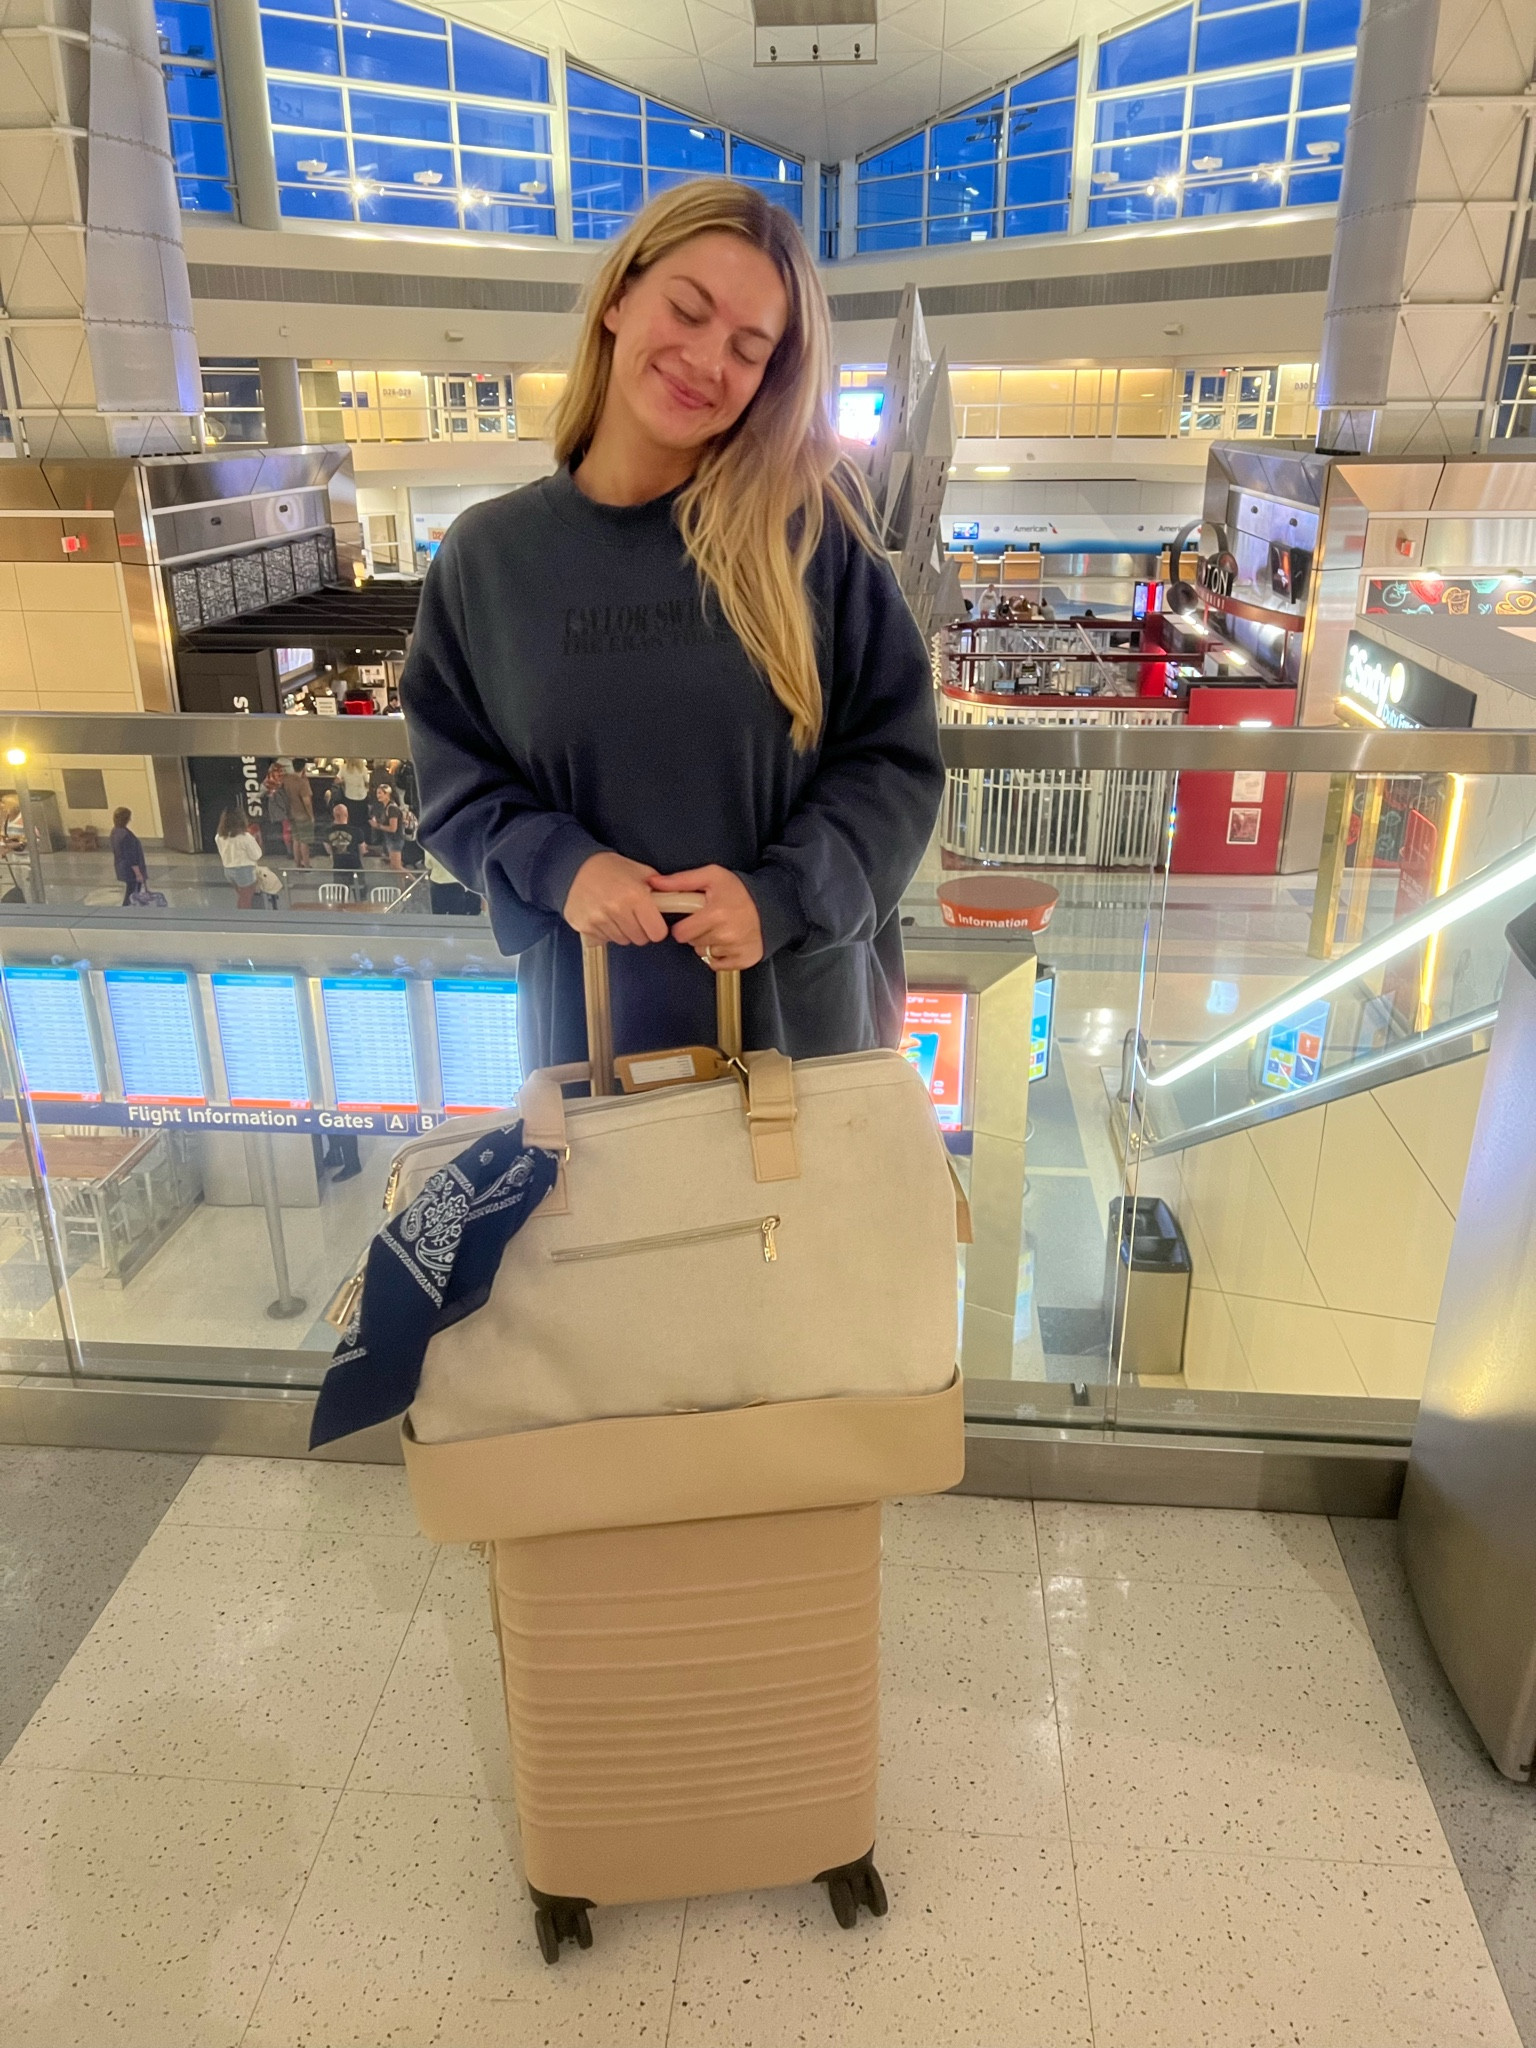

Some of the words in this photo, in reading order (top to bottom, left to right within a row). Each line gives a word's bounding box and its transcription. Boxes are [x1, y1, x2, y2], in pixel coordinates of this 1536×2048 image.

[1013, 524, 1048, 533] American
[958, 913, 1028, 929] Information
[128, 1106, 182, 1126] Flight
[187, 1107, 297, 1127] Information
[318, 1112, 374, 1129] Gates
[390, 1114, 404, 1129] A
[421, 1115, 434, 1130] B
